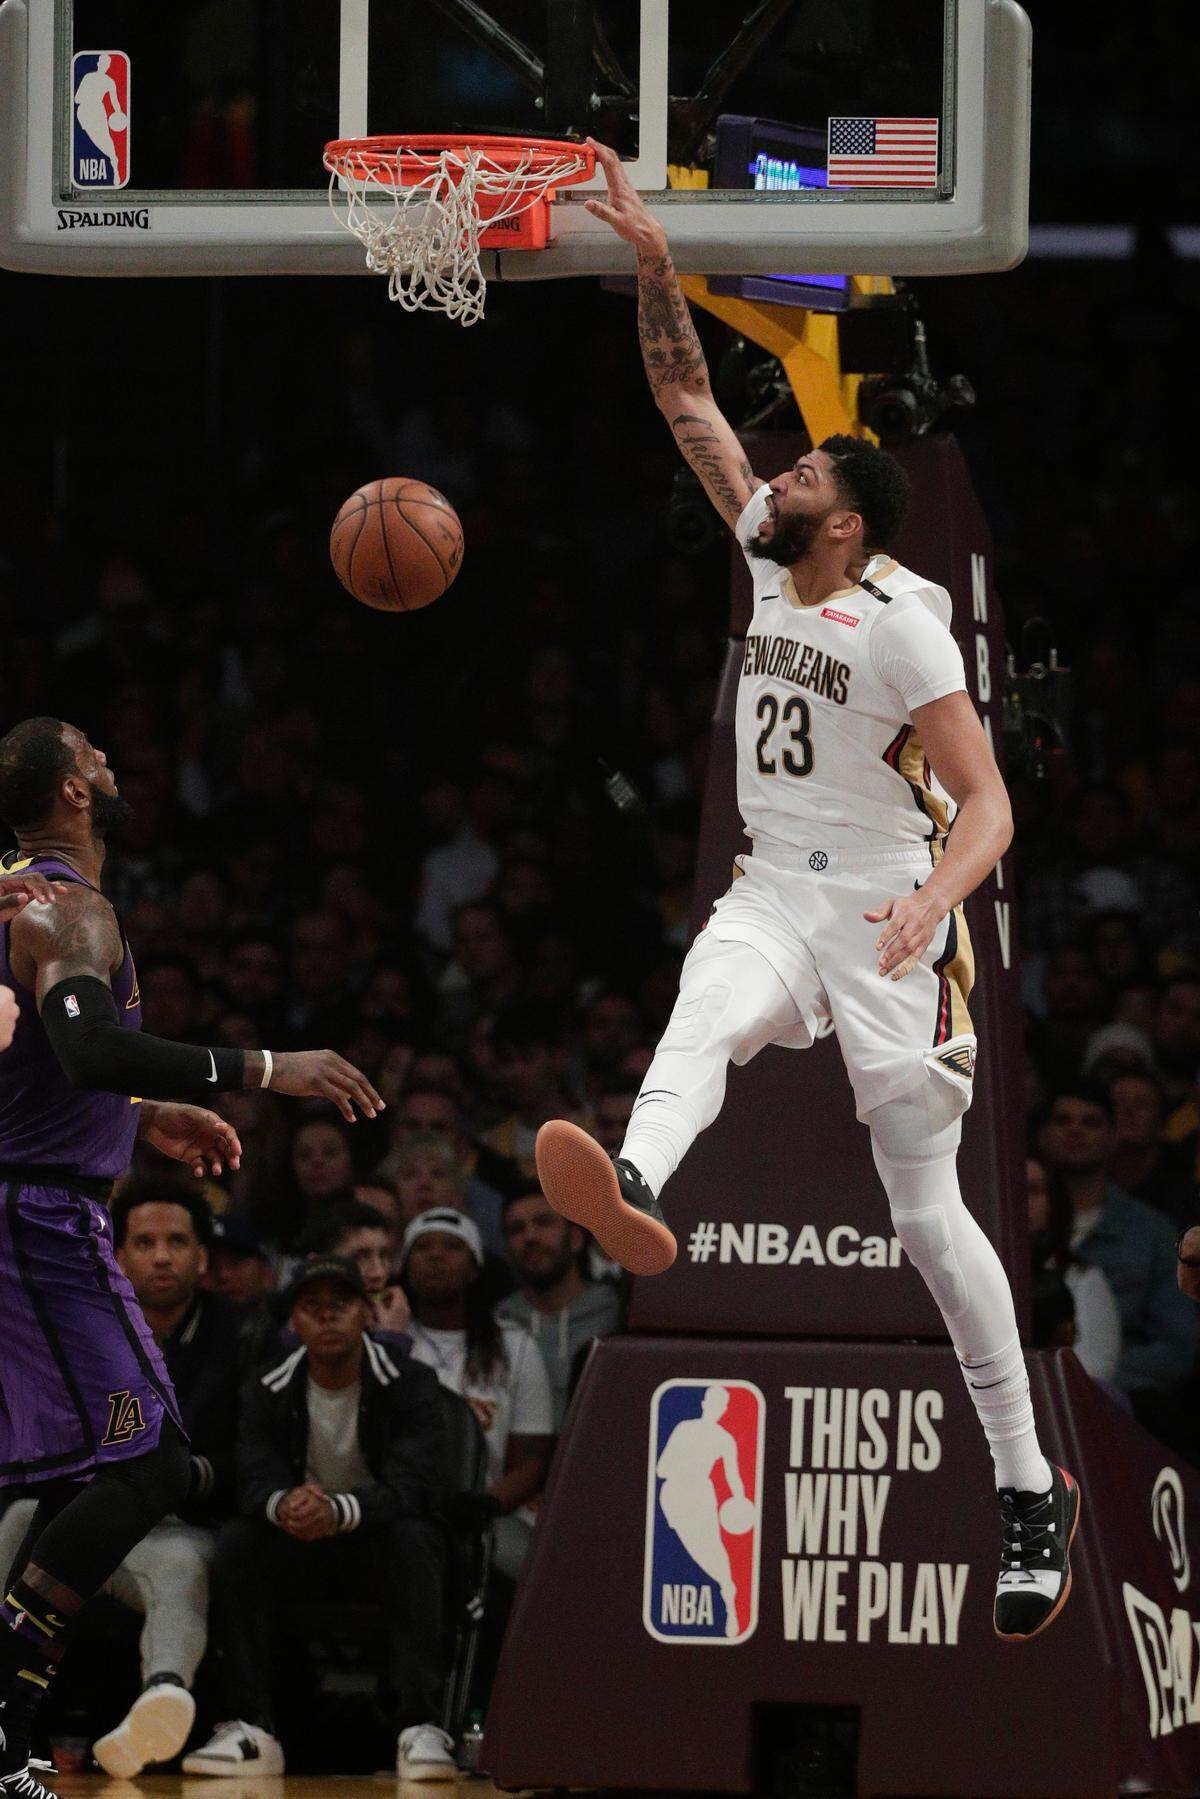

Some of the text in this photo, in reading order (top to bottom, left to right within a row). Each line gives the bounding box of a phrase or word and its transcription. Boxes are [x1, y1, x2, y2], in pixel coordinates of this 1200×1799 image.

[79, 158, 108, 180] NBA
[57, 208, 149, 231] SPALDING
[756, 692, 816, 779] 23
[687, 1221, 903, 1268] #NBACar
[102, 1390, 146, 1447] LA
[783, 1386, 944, 1473] THIS IS
[784, 1472, 892, 1557] WHY
[660, 1583, 714, 1626] NBA
[781, 1558, 970, 1646] WE PLAY
